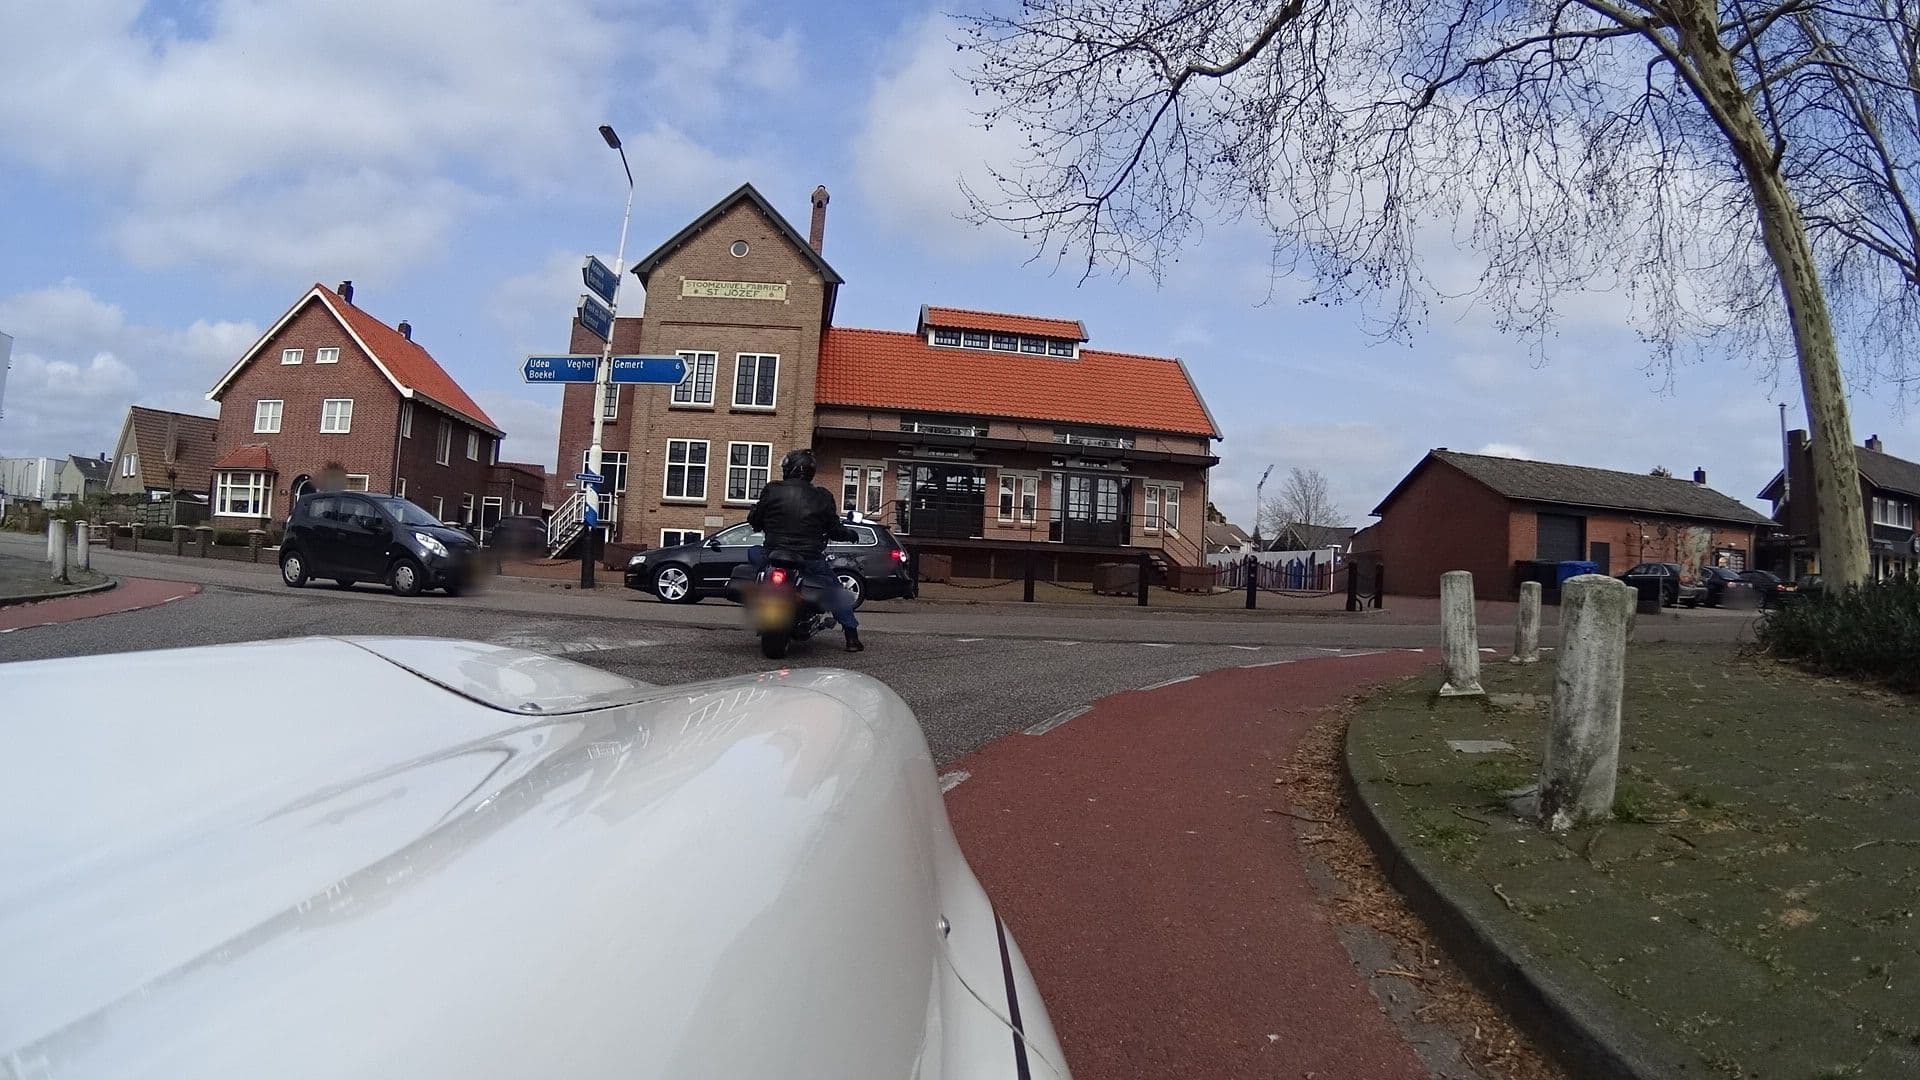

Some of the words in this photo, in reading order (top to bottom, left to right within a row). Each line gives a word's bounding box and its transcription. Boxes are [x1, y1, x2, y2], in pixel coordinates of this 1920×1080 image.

[686, 281, 784, 291] STOOMZUIVELFABRIEK
[724, 290, 760, 298] JOZEF
[530, 360, 550, 368] Uden
[567, 360, 594, 370] Veghel
[614, 360, 644, 368] Gemert
[529, 370, 555, 378] Boekel
